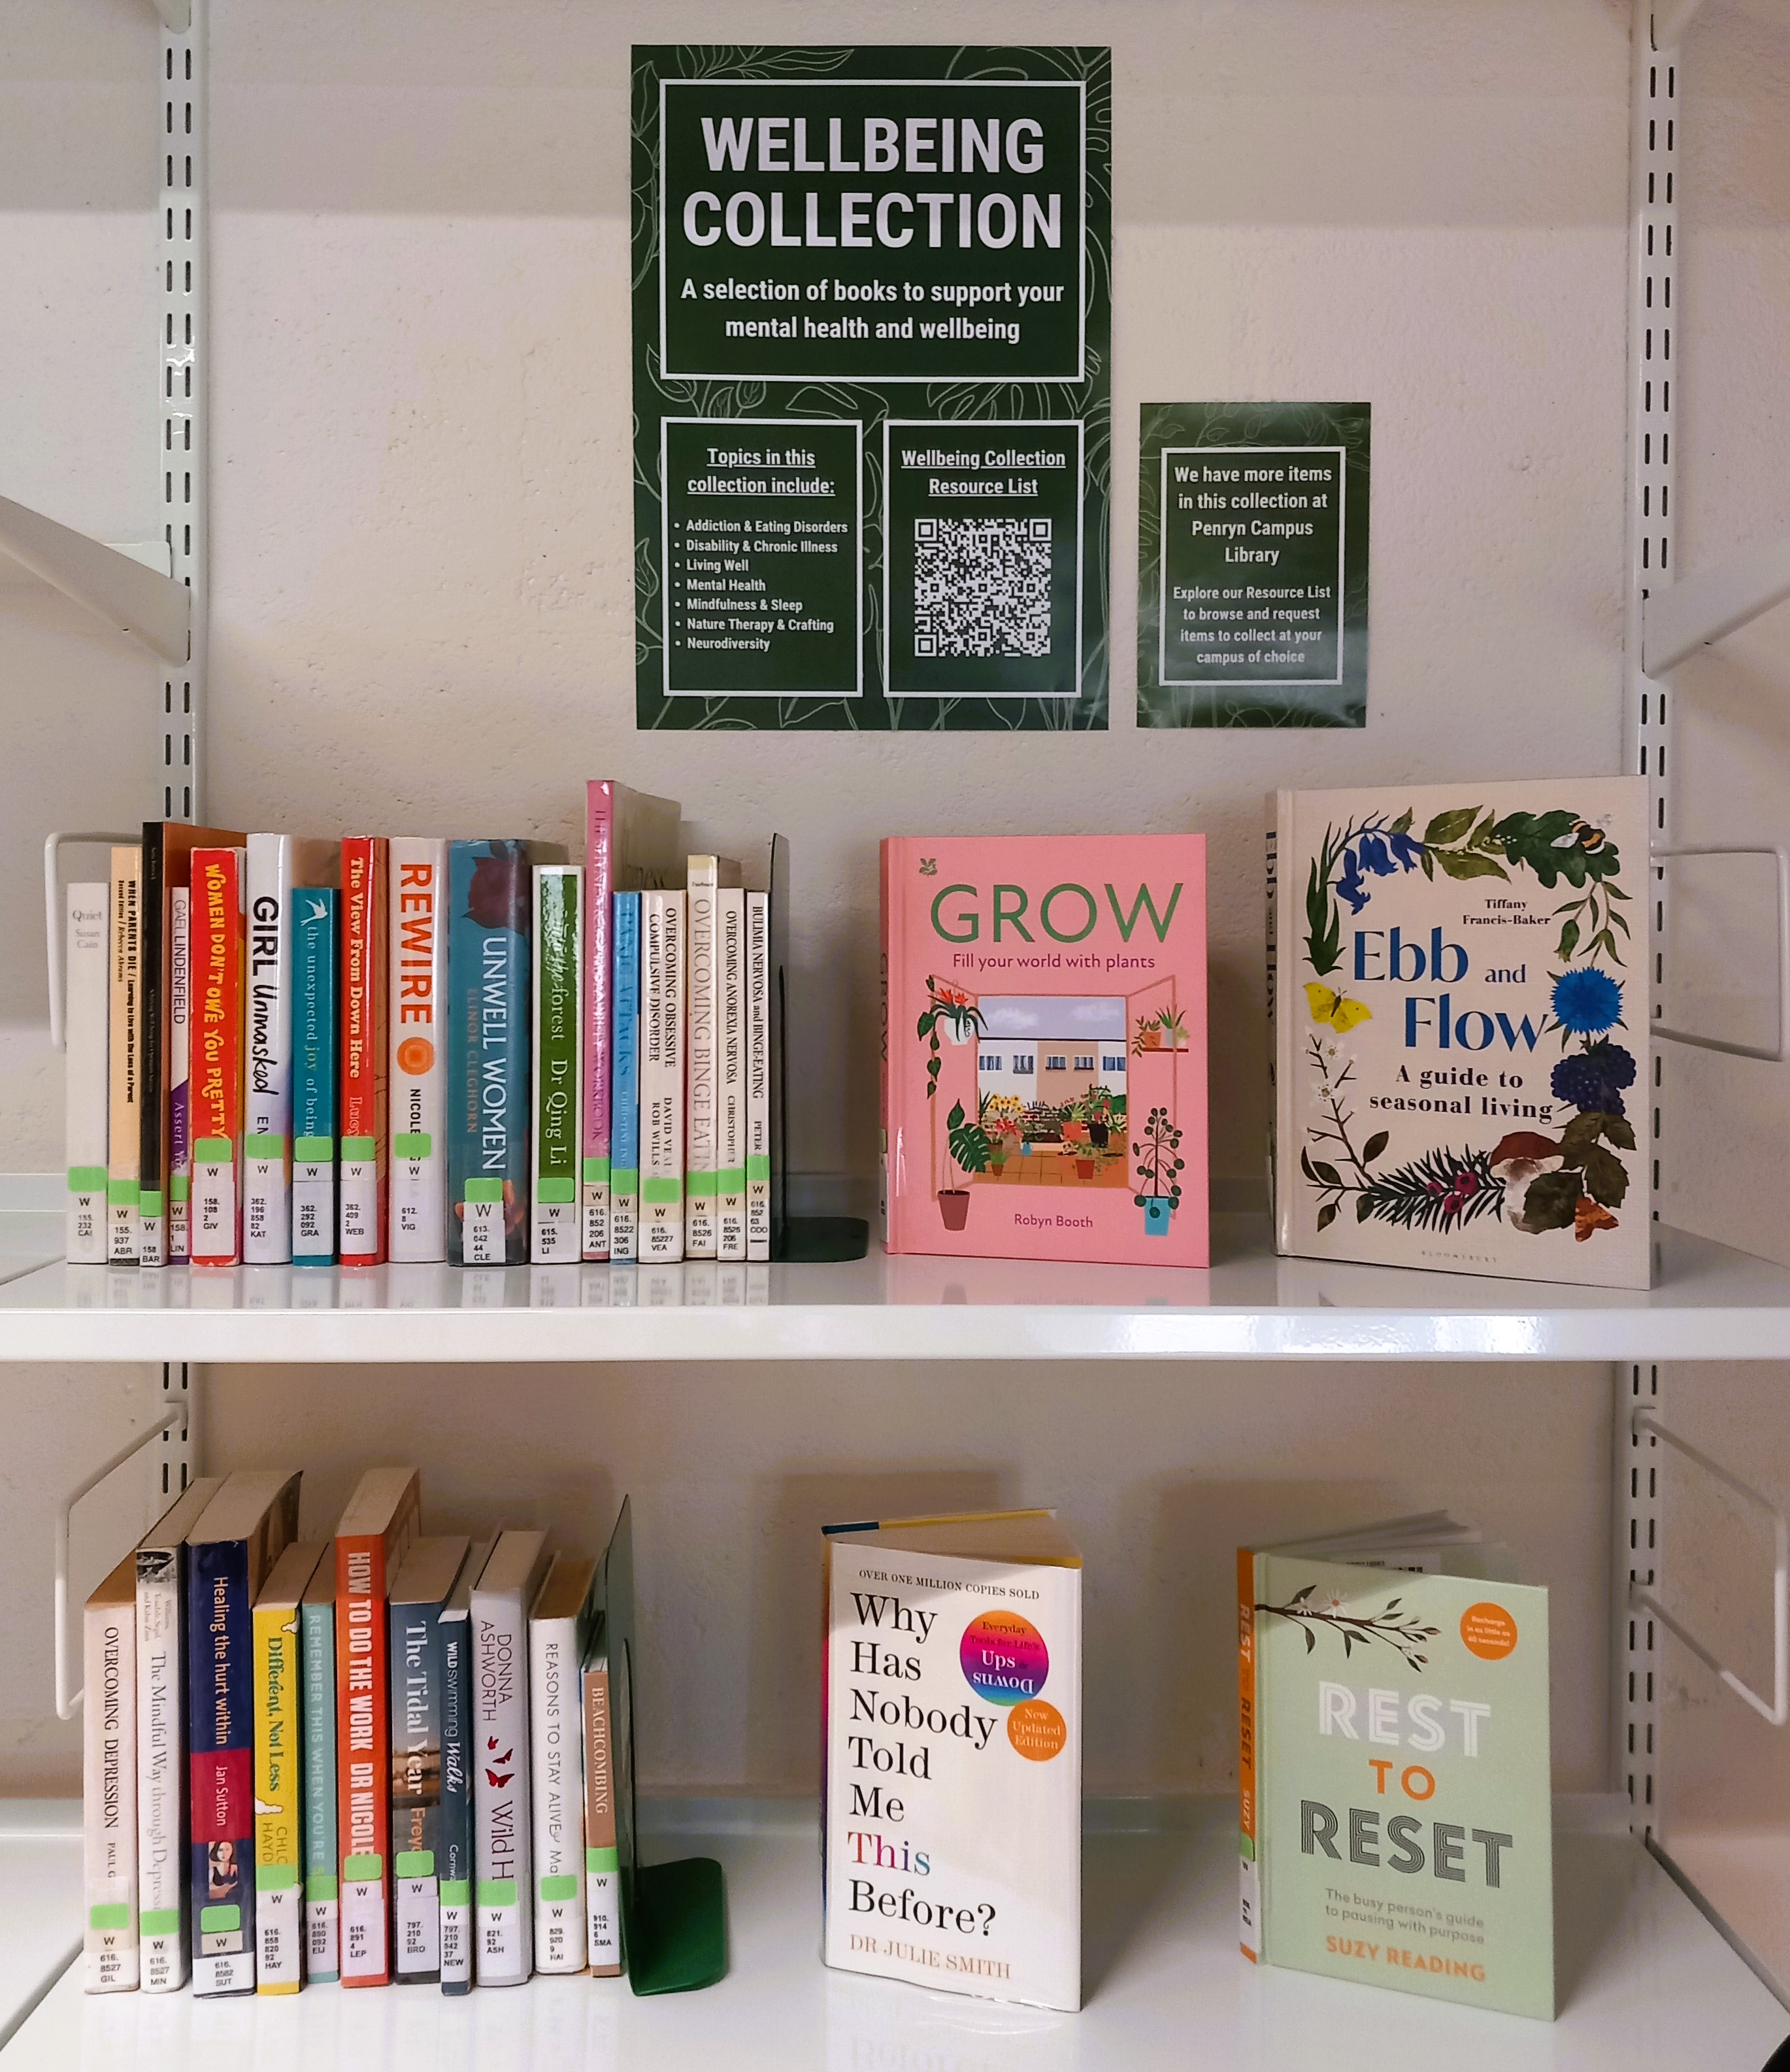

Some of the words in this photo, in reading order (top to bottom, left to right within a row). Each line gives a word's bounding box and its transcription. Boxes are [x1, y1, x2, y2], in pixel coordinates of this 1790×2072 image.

[701, 117, 1044, 173] WELLBEING
[683, 192, 1061, 249] COLLECTION
[680, 278, 697, 299] A
[703, 278, 799, 301] selection
[806, 279, 829, 301] of
[833, 280, 897, 302] books
[904, 282, 925, 302] to
[931, 282, 1012, 307] support
[1018, 285, 1065, 307] your
[725, 316, 797, 338] mental
[804, 317, 869, 339] health
[876, 318, 913, 339] and
[920, 319, 1020, 344] wellbeing
[707, 448, 761, 467] Topics
[767, 449, 780, 465] in
[785, 449, 815, 465] this
[901, 450, 980, 469] Wellbeing
[985, 451, 1066, 467] Collection
[1175, 467, 1199, 482] We
[1203, 467, 1240, 482] have
[1244, 469, 1284, 481] more
[1288, 466, 1332, 481] items
[688, 477, 767, 493] collection
[772, 478, 835, 494] include:
[929, 478, 1004, 495] Resource
[1008, 479, 1038, 495] List
[1178, 494, 1193, 509] in
[1197, 493, 1226, 509] this
[1231, 493, 1308, 509] collection
[1312, 495, 1328, 508] at
[686, 520, 741, 533] Addiction
[744, 521, 752, 532] &
[755, 521, 790, 535] Eating
[793, 522, 848, 534] Disorders
[1192, 521, 1246, 539] Penryn
[1251, 521, 1314, 539] Campus
[686, 539, 739, 554] Disability
[740, 541, 750, 552] &
[754, 540, 797, 552] Chronic
[801, 541, 838, 553] Illness
[1225, 547, 1279, 566] Library
[687, 559, 721, 574] Living
[724, 560, 749, 571] Well
[687, 579, 725, 591] Mental
[729, 579, 766, 592] Health
[1174, 587, 1219, 601] Explore
[1223, 589, 1243, 599] our
[1246, 586, 1304, 599] Resource
[1308, 586, 1331, 598] List
[687, 599, 756, 611] Mindfulness
[760, 599, 768, 610] &
[771, 599, 803, 613] Sleep
[1184, 609, 1195, 620] to
[1199, 608, 1243, 620] browse
[1247, 608, 1269, 620] and
[1273, 608, 1320, 622] request
[687, 618, 725, 631] Nature
[729, 619, 774, 633] Therapy
[778, 620, 786, 630] &
[789, 619, 834, 633] Crafting
[1180, 629, 1215, 642] items
[1219, 629, 1230, 641] to
[1234, 629, 1274, 641] collect
[1279, 629, 1291, 641] at
[1295, 631, 1322, 644] your
[687, 637, 770, 652] Neurodiversity
[1197, 652, 1244, 666] campus
[1248, 651, 1261, 663] of
[1265, 651, 1305, 663] choice
[350, 857, 364, 888] The
[205, 863, 226, 928] WOMEN
[350, 892, 363, 935] View
[931, 883, 1184, 943] GROW
[1485, 899, 1528, 911] Tiffany
[174, 899, 186, 934] GAEL
[1463, 915, 1551, 925] Francis-Baker
[253, 896, 279, 976] GIRL
[401, 864, 432, 1024] REWIRE
[1354, 926, 1469, 982] Ebb
[1485, 964, 1526, 983] and
[208, 934, 225, 985] DON'T
[350, 939, 363, 982] From
[953, 954, 974, 967] Fill
[978, 957, 1013, 972] your
[1018, 954, 1060, 968] world
[1065, 954, 1101, 968] with
[1106, 954, 1155, 972] plants
[174, 935, 186, 1024] LINDENFIELD
[482, 937, 507, 1050] UNWELL
[204, 987, 225, 1023] OWE
[350, 986, 363, 1035] Down
[1406, 993, 1549, 1053] Flow
[203, 1029, 225, 1061] YOU
[252, 984, 279, 1095] Unmasked
[350, 1039, 363, 1078] Here
[1396, 1065, 1410, 1082] A
[1420, 1067, 1489, 1089] guide
[1499, 1071, 1523, 1088] to
[202, 1067, 225, 1139] PRETTY
[482, 1058, 507, 1169] WOMEN
[1370, 1096, 1470, 1114] seasonal
[1482, 1097, 1553, 1124] living
[1015, 1214, 1052, 1228] Robyn
[1056, 1216, 1093, 1228] Booth
[348, 1552, 371, 1594] HOW
[859, 1569, 888, 1582] OVER
[891, 1573, 912, 1584] ONE
[916, 1577, 962, 1591] MILLION
[965, 1584, 1005, 1596] COPIES
[1010, 1589, 1040, 1599] SOLD
[209, 1577, 229, 1631] Healing
[349, 1599, 371, 1622] TO
[850, 1592, 938, 1644] Why
[215, 1634, 229, 1659] the
[349, 1628, 372, 1653] DO
[214, 1663, 231, 1694] hurt
[349, 1656, 372, 1691] THE
[480, 1621, 496, 1721] ASHWORTH
[497, 1634, 512, 1704] DONNA
[850, 1641, 921, 1680] Has
[982, 1650, 1016, 1670] Ups
[973, 1673, 1034, 1694] Downs
[215, 1697, 231, 1745] within
[350, 1694, 373, 1751] WORK
[850, 1688, 998, 1750] Nobody
[1319, 1680, 1491, 1758] REST
[591, 1687, 608, 1814] BEACHCOMBING
[848, 1736, 932, 1780] Told
[216, 1766, 227, 1785] Jan
[1368, 1759, 1435, 1801] TO
[216, 1787, 229, 1826] Sutton
[850, 1784, 904, 1822] Me
[848, 1831, 931, 1876] This
[1301, 1799, 1513, 1888] RESET
[848, 1879, 996, 1936] Before?
[1325, 1888, 1350, 1903] The
[1353, 1894, 1383, 1909] busy
[1387, 1901, 1442, 1920] person's
[1446, 1911, 1484, 1928] guide
[1326, 1905, 1338, 1916] to
[1342, 1909, 1394, 1930] pausing
[1398, 1919, 1425, 1933] with
[1429, 1926, 1484, 1945] purpose
[850, 1934, 877, 1953] DR
[884, 1940, 940, 1967] JULIE
[946, 1955, 1011, 1979] SMITH
[1326, 1935, 1380, 1960] SUZY
[1387, 1946, 1485, 1982] READING
